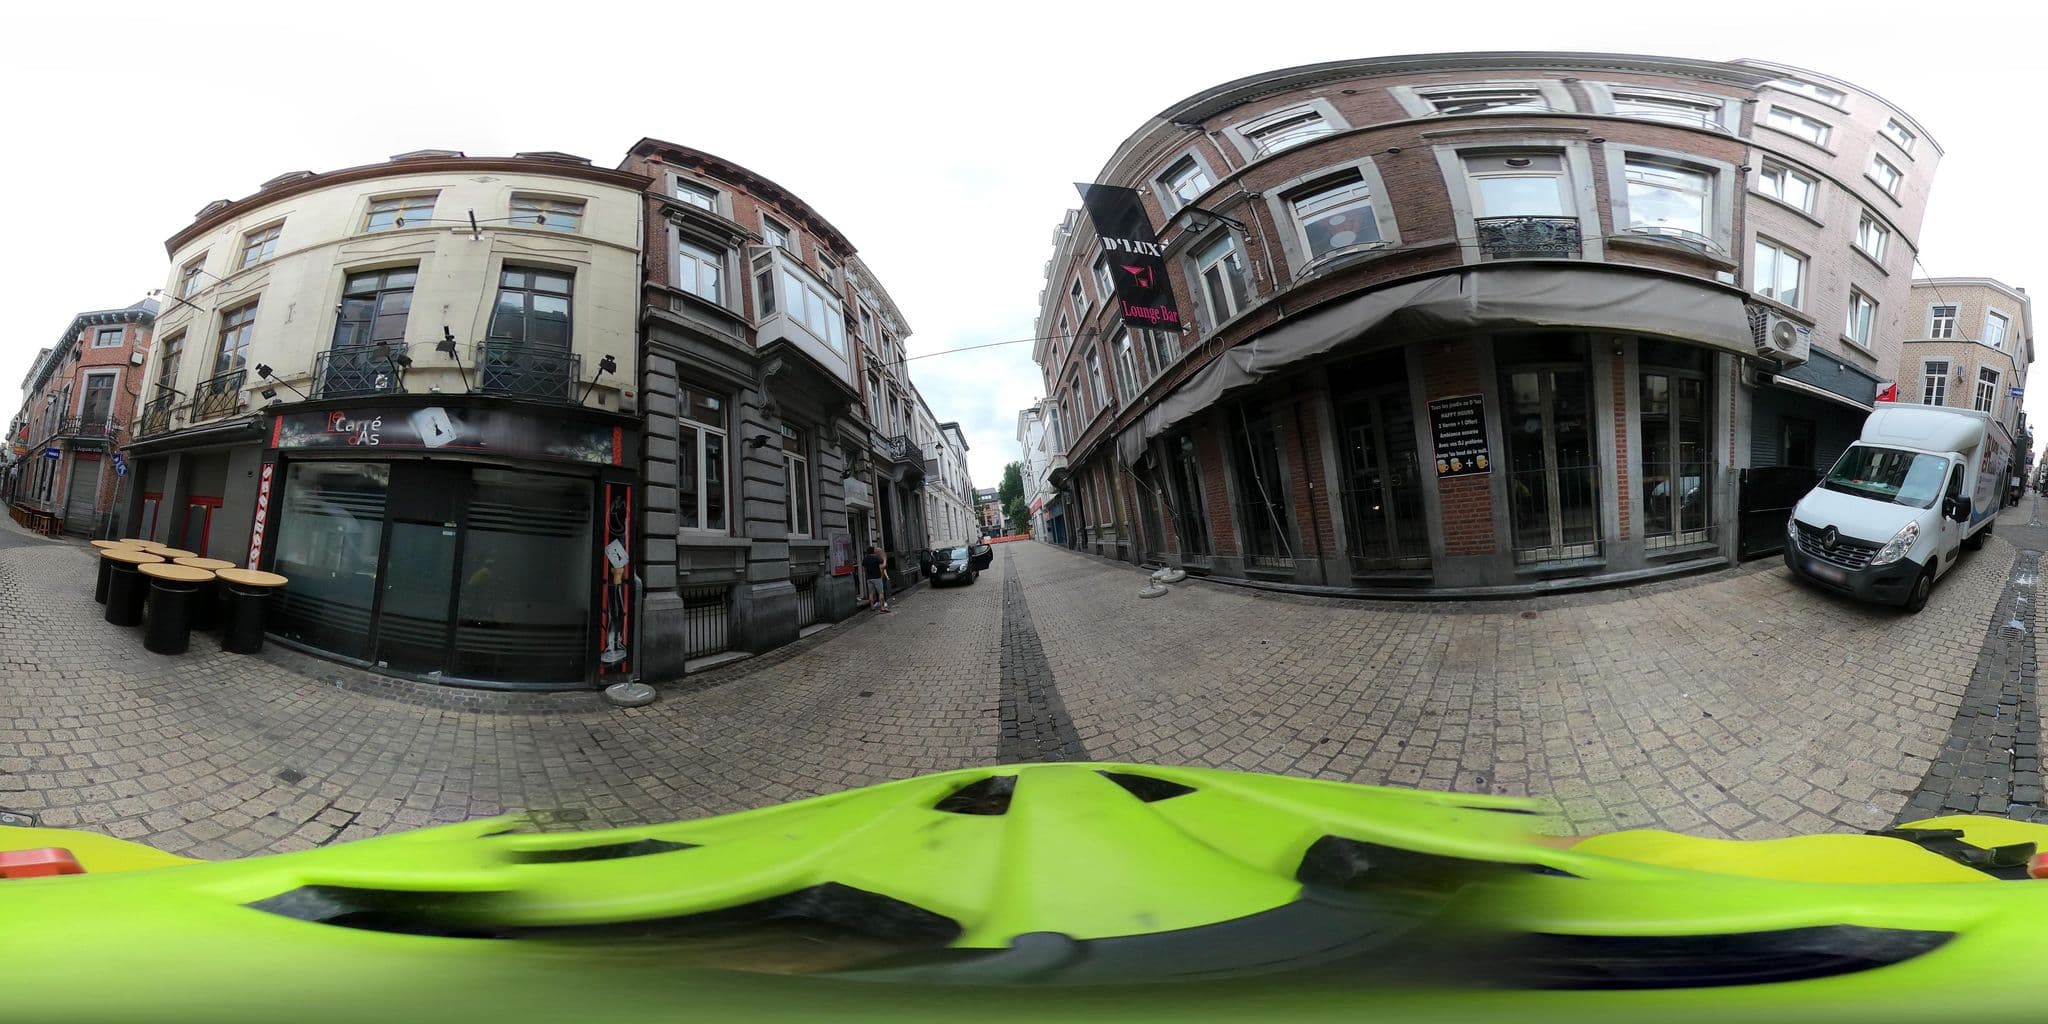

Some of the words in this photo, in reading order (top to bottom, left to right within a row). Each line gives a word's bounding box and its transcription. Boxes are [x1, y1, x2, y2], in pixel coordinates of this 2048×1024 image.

[1102, 236, 1161, 257] D'LUX
[1122, 300, 1160, 323] Lounge
[1160, 305, 1179, 323] Bar
[327, 411, 345, 432] Le
[335, 416, 382, 432] Carré
